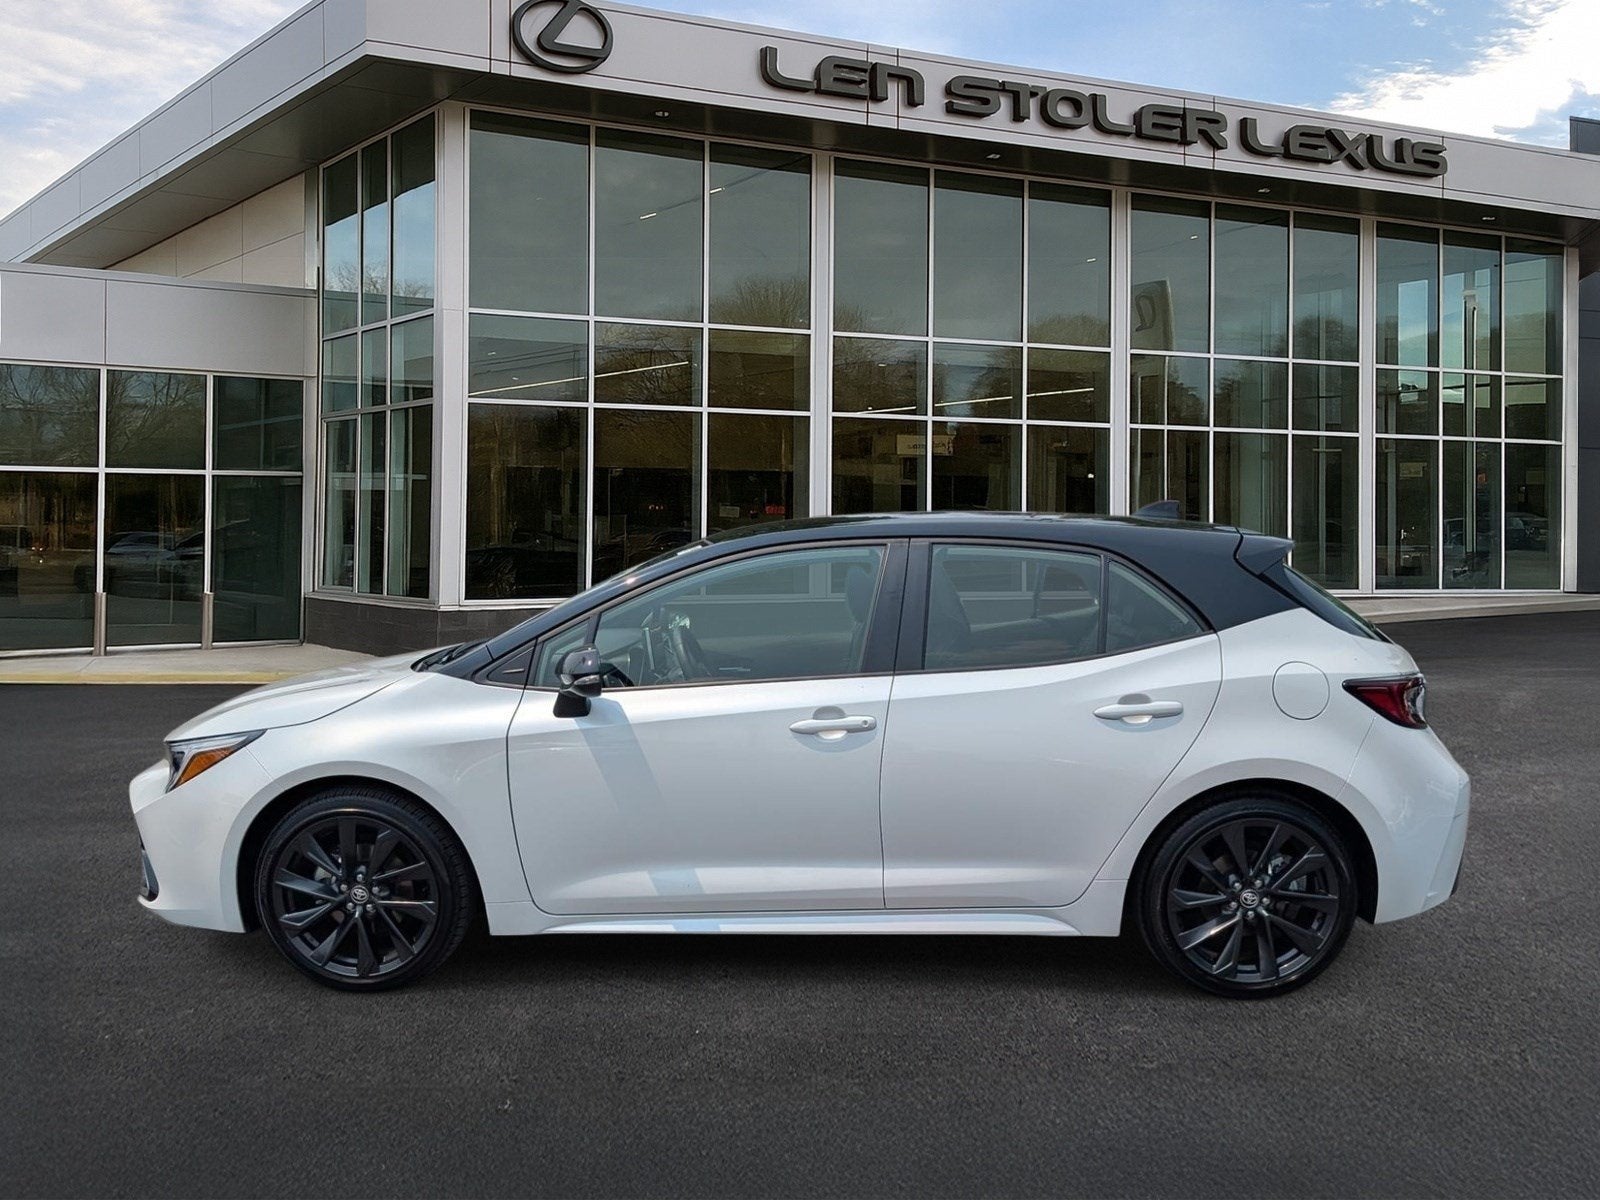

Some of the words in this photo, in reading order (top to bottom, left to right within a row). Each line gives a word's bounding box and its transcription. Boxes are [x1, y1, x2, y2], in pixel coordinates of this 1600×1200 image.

[760, 46, 925, 107] LEN
[945, 75, 1228, 150] STOLER
[1240, 117, 1448, 177] LEXUS
